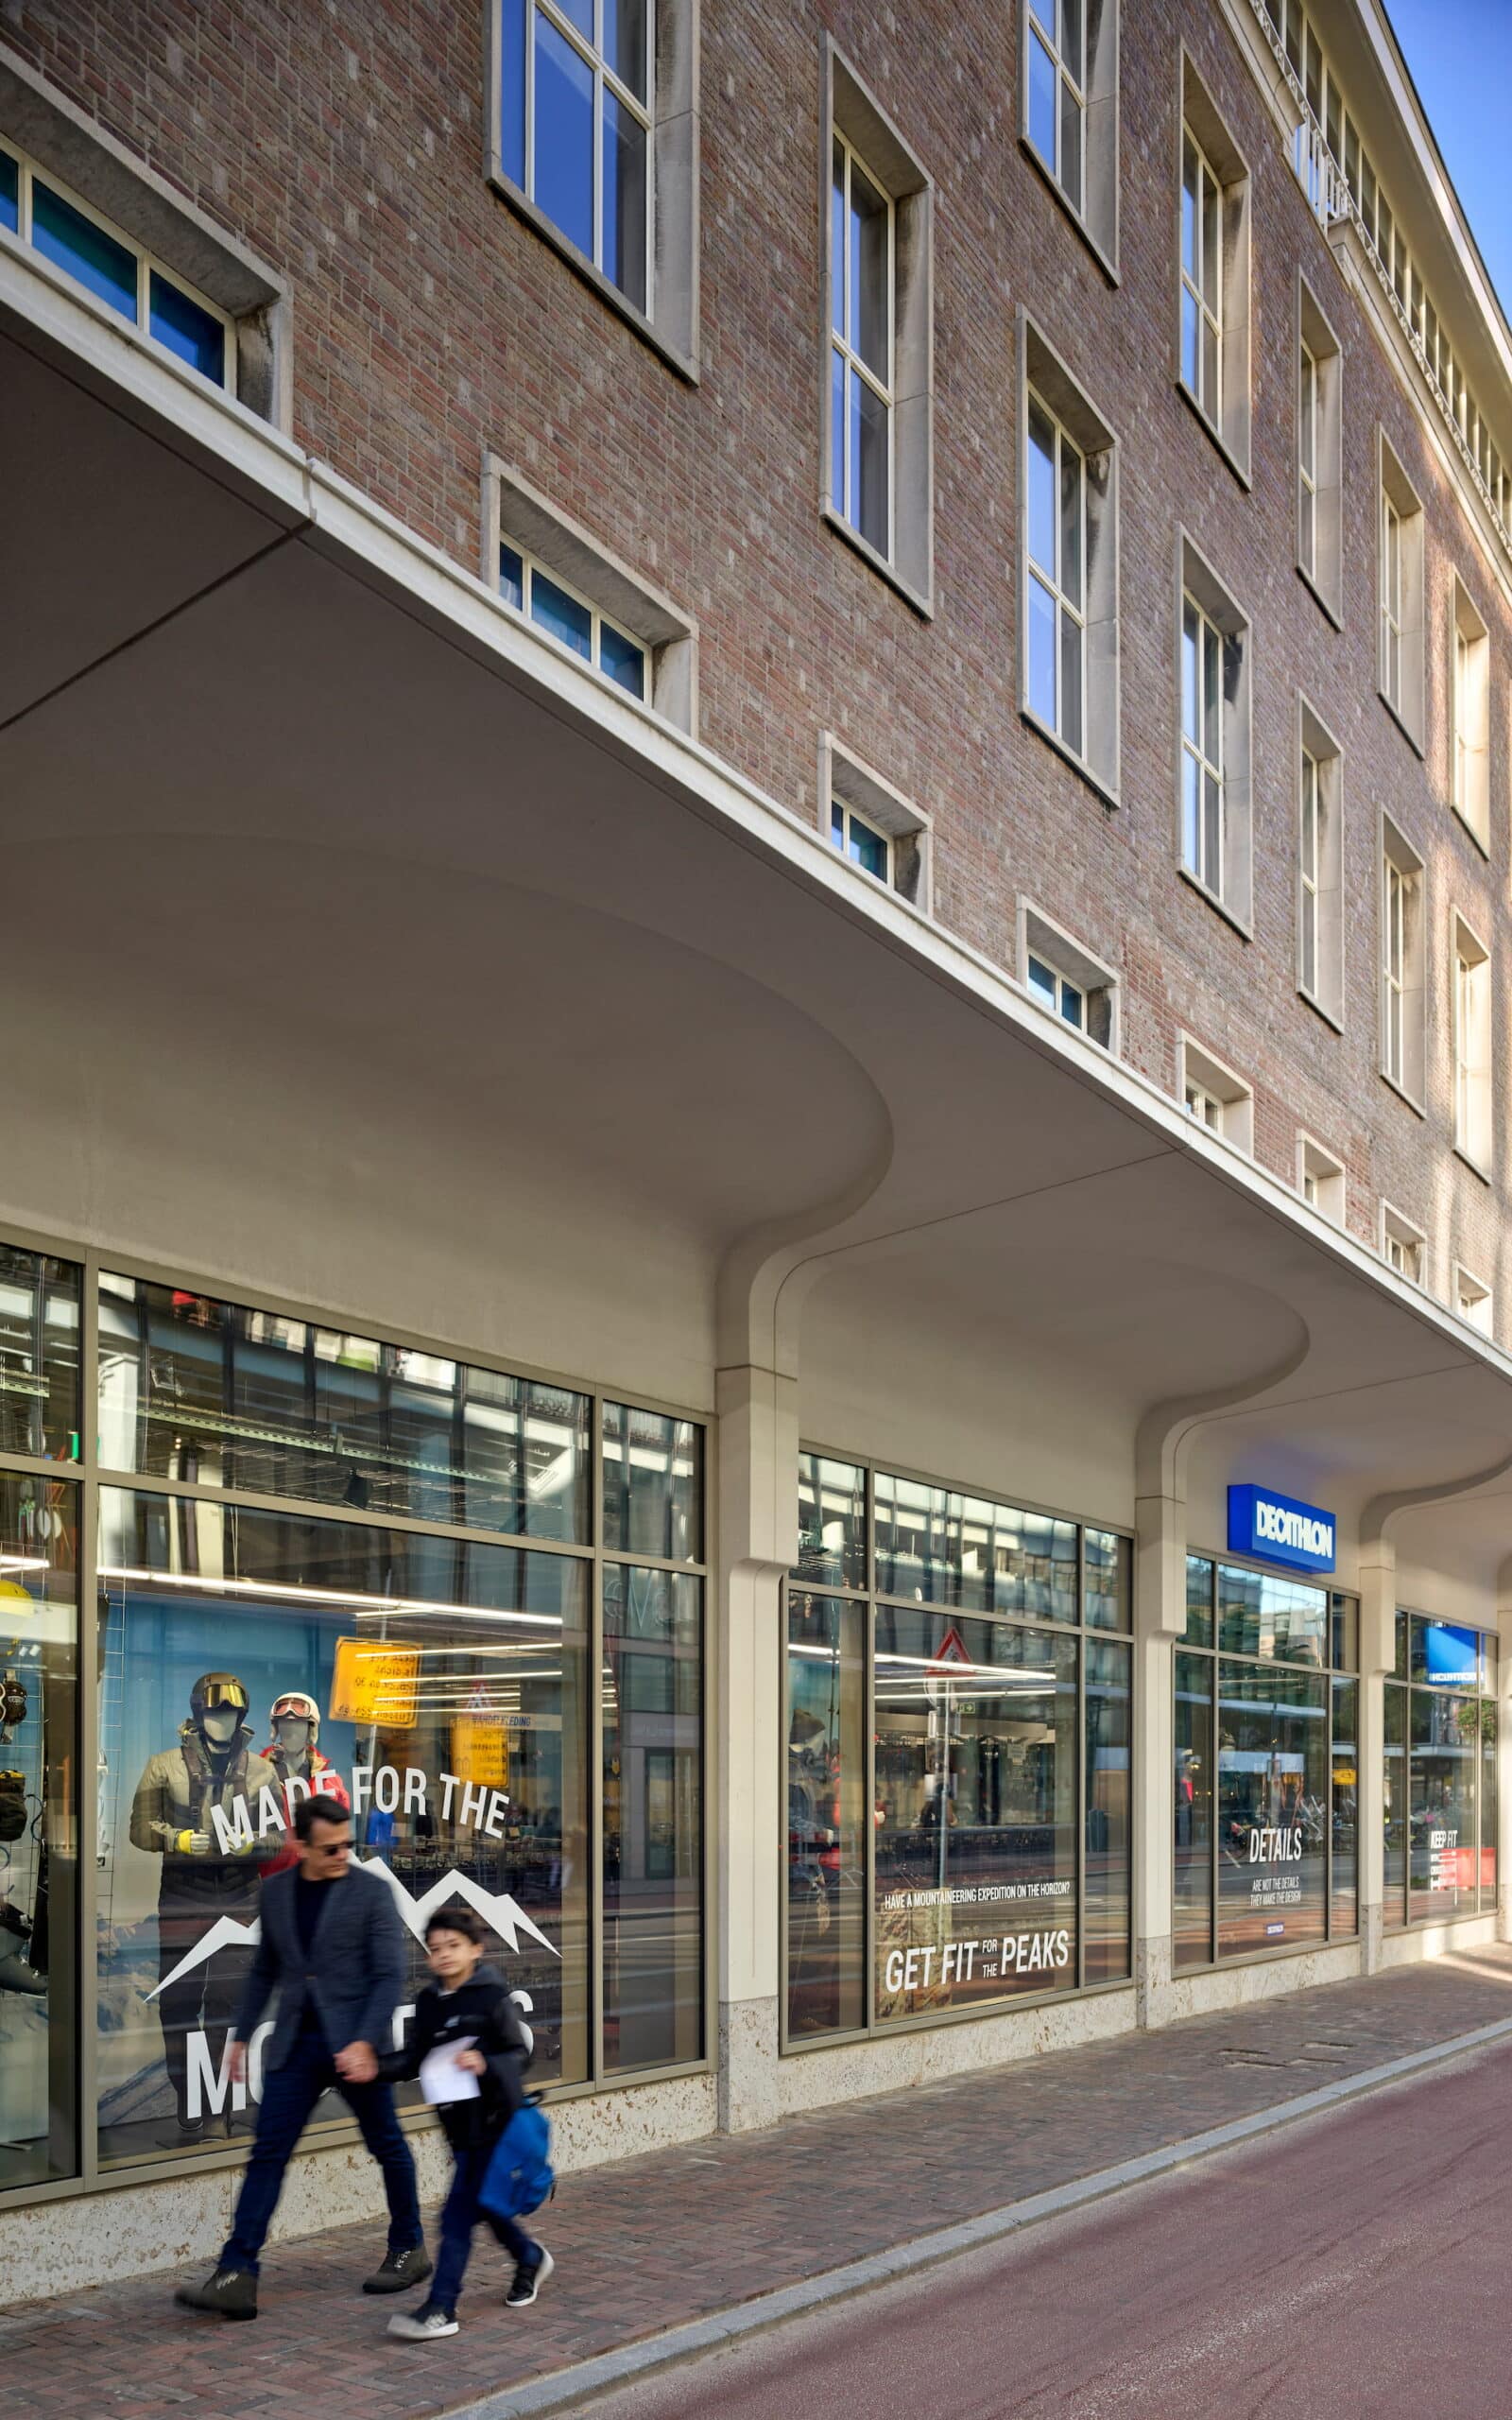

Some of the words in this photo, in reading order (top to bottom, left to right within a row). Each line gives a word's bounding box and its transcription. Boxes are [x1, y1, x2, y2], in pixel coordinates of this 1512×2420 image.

[1257, 1500, 1332, 1558] DECATHLON
[352, 1765, 427, 1816] FOR
[439, 1772, 510, 1839] THE
[1249, 1827, 1302, 1863] DETAILS
[1430, 1830, 1447, 1849] KEEP
[1447, 1829, 1458, 1848] FIT
[885, 1893, 906, 1910] HAVE
[907, 1893, 913, 1908] A
[913, 1889, 977, 1908] MOUNTAINEERING
[978, 1884, 1017, 1902] EXPEDITION
[1017, 1883, 1027, 1899] ON
[1027, 1883, 1040, 1897] THE
[1040, 1880, 1071, 1897] HORIZON?
[1272, 1876, 1281, 1891] THE
[1281, 1876, 1299, 1890] DETAILS
[1276, 1891, 1285, 1905] THE
[983, 1939, 997, 1954] FOR
[1002, 1929, 1069, 1976] PEAKS
[885, 1945, 936, 1994] GET
[941, 1941, 978, 1985] FIT
[983, 1962, 997, 1979] THE
